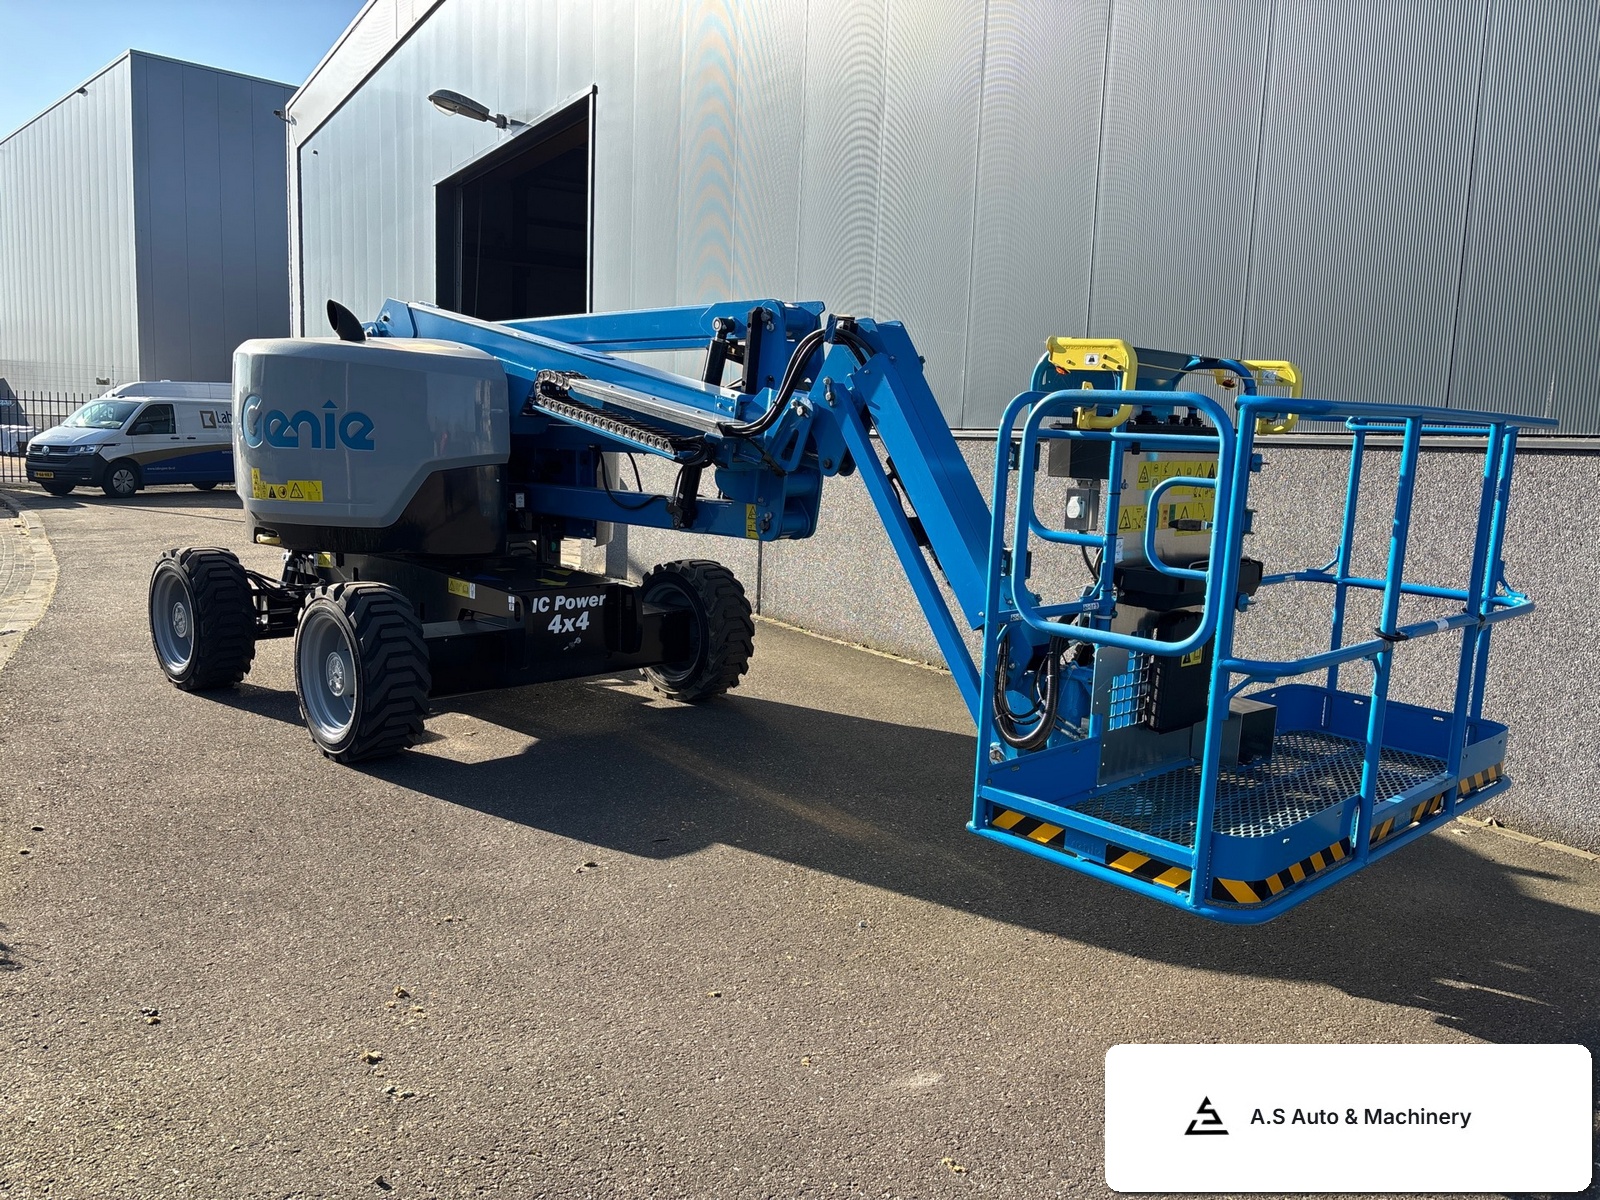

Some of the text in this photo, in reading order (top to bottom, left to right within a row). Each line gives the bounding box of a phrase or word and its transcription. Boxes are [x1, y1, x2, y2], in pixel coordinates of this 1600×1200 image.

[242, 394, 376, 452] Genie
[532, 594, 607, 614] IC Power
[547, 611, 590, 634] 4x4
